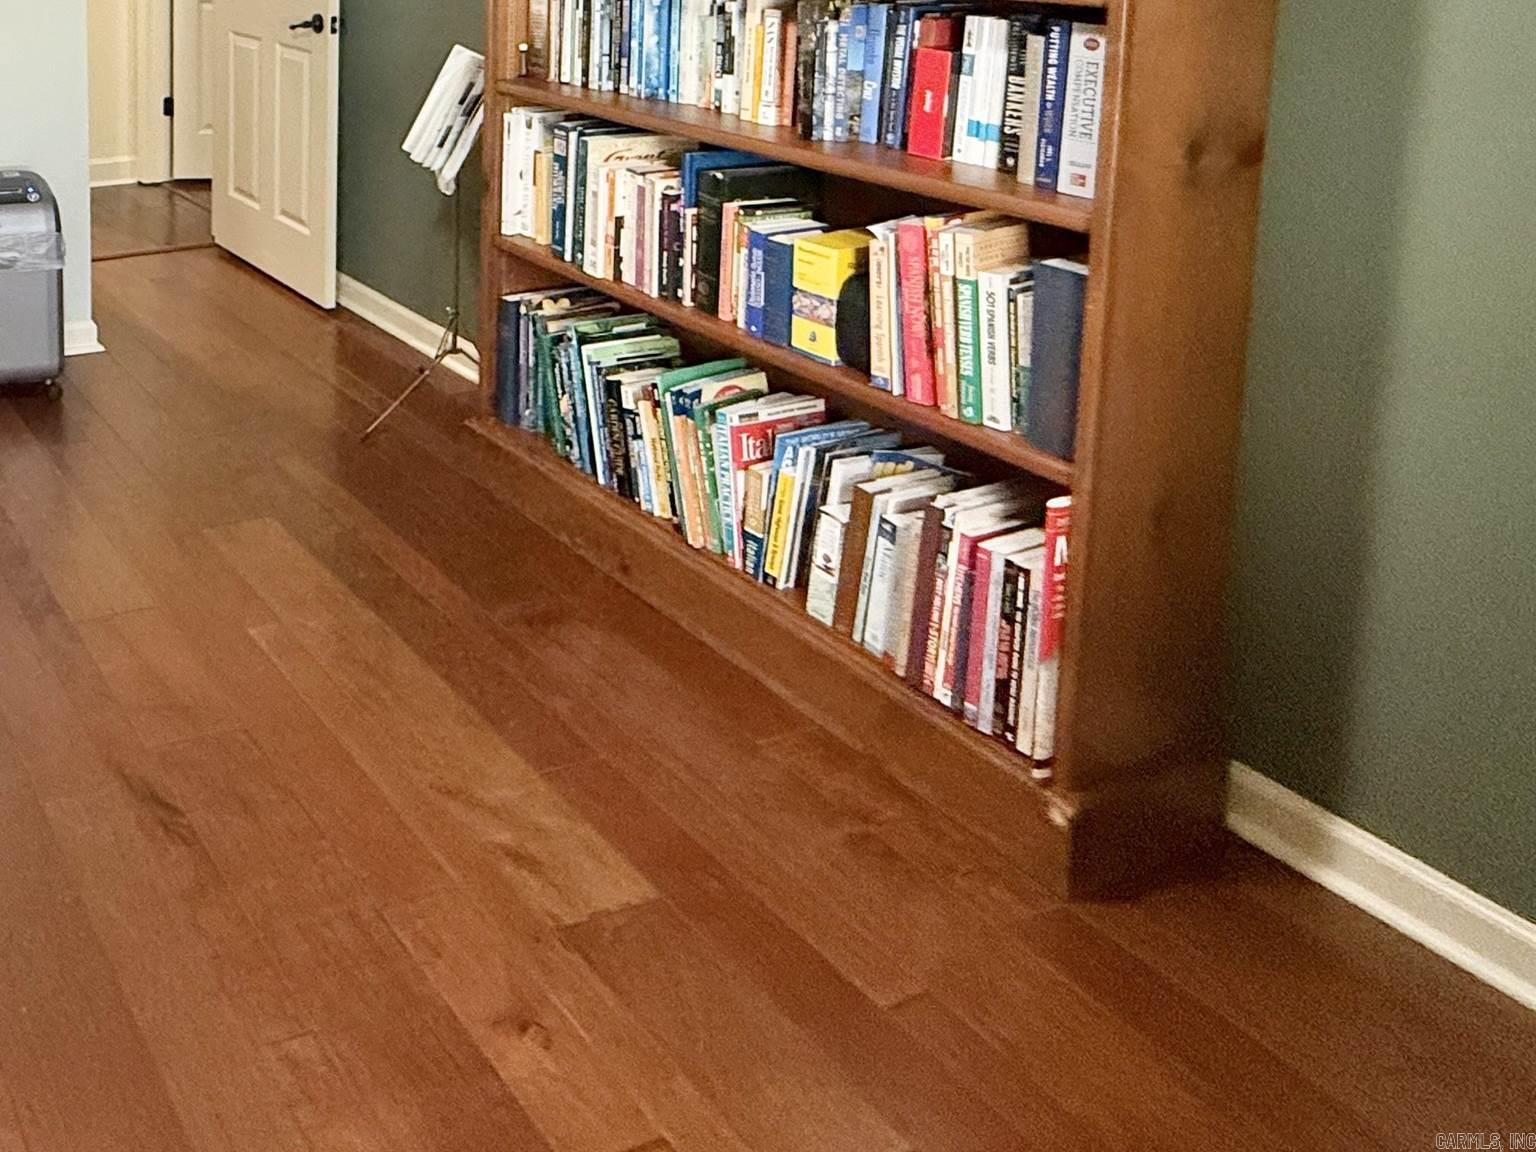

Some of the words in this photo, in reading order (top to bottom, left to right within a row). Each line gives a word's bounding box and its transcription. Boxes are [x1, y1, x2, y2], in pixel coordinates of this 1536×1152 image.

[837, 33, 849, 68] METAL
[1048, 25, 1061, 65] PUTTING
[835, 68, 848, 120] DETECTING
[1045, 65, 1058, 101] WEALTH
[1068, 59, 1085, 139] COMPENSATION
[1081, 61, 1099, 141] EXECUTIVE
[958, 283, 973, 320] SPANISH
[986, 291, 996, 308] 501
[958, 320, 972, 343] VERB
[986, 308, 996, 339] SPANISH
[959, 343, 973, 376] TENSES
[987, 340, 996, 366] VERBS
[716, 424, 729, 468] ITALIAN
[740, 428, 774, 462] Ital
[719, 470, 732, 522] PRACTICE
[745, 539, 758, 575] Italian
